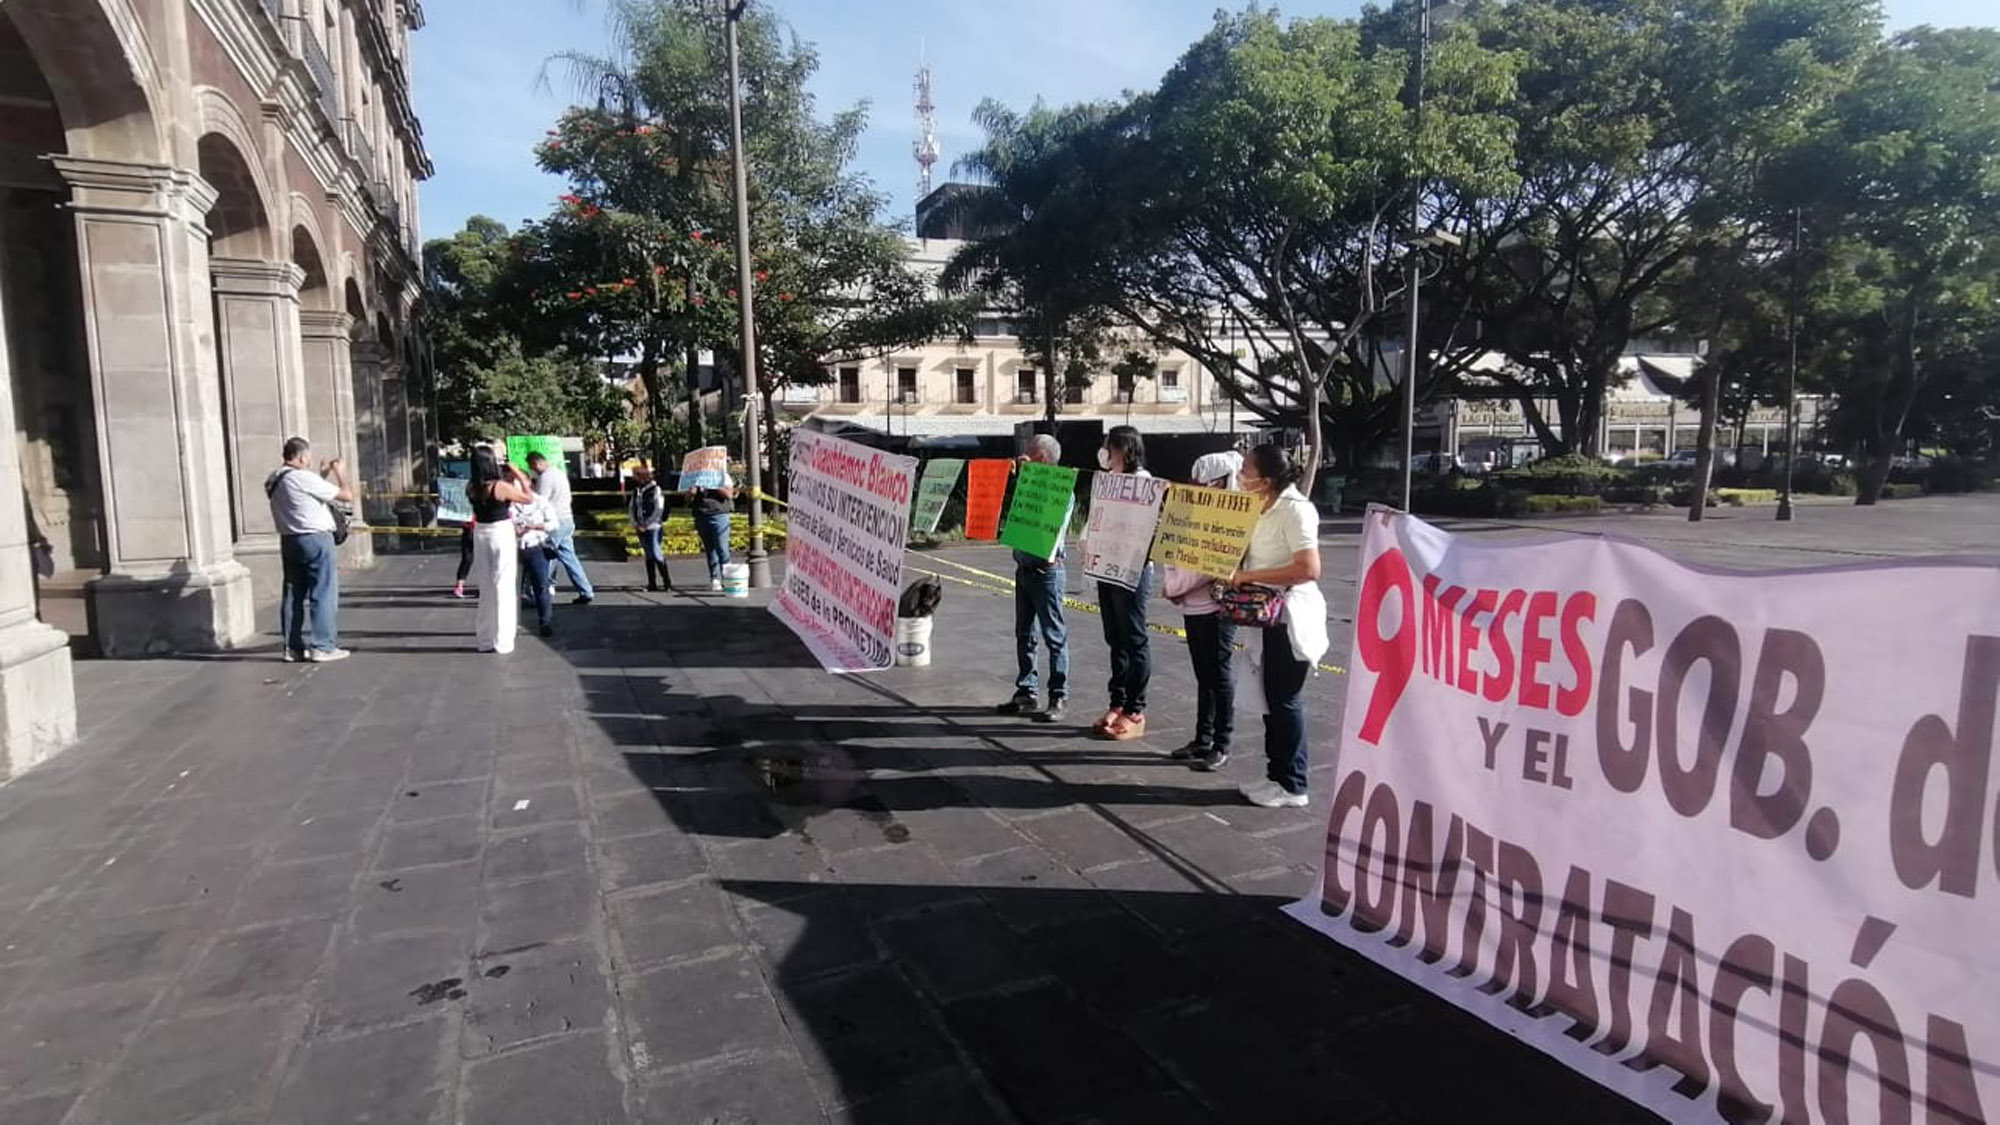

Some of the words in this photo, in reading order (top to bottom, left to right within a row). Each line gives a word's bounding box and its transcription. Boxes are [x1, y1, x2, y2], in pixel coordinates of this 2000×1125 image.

[868, 453, 908, 505] Blanco
[1098, 472, 1161, 506] MORELOS
[838, 491, 905, 548] INTERVENCIÓN
[876, 550, 900, 588] Salud
[832, 605, 892, 668] PROMETIDO
[1358, 547, 1416, 746] 9
[1420, 574, 1596, 717] MESES
[1476, 717, 1508, 770] Y
[1522, 730, 1573, 790] EL
[1596, 598, 1840, 862] GOB.
